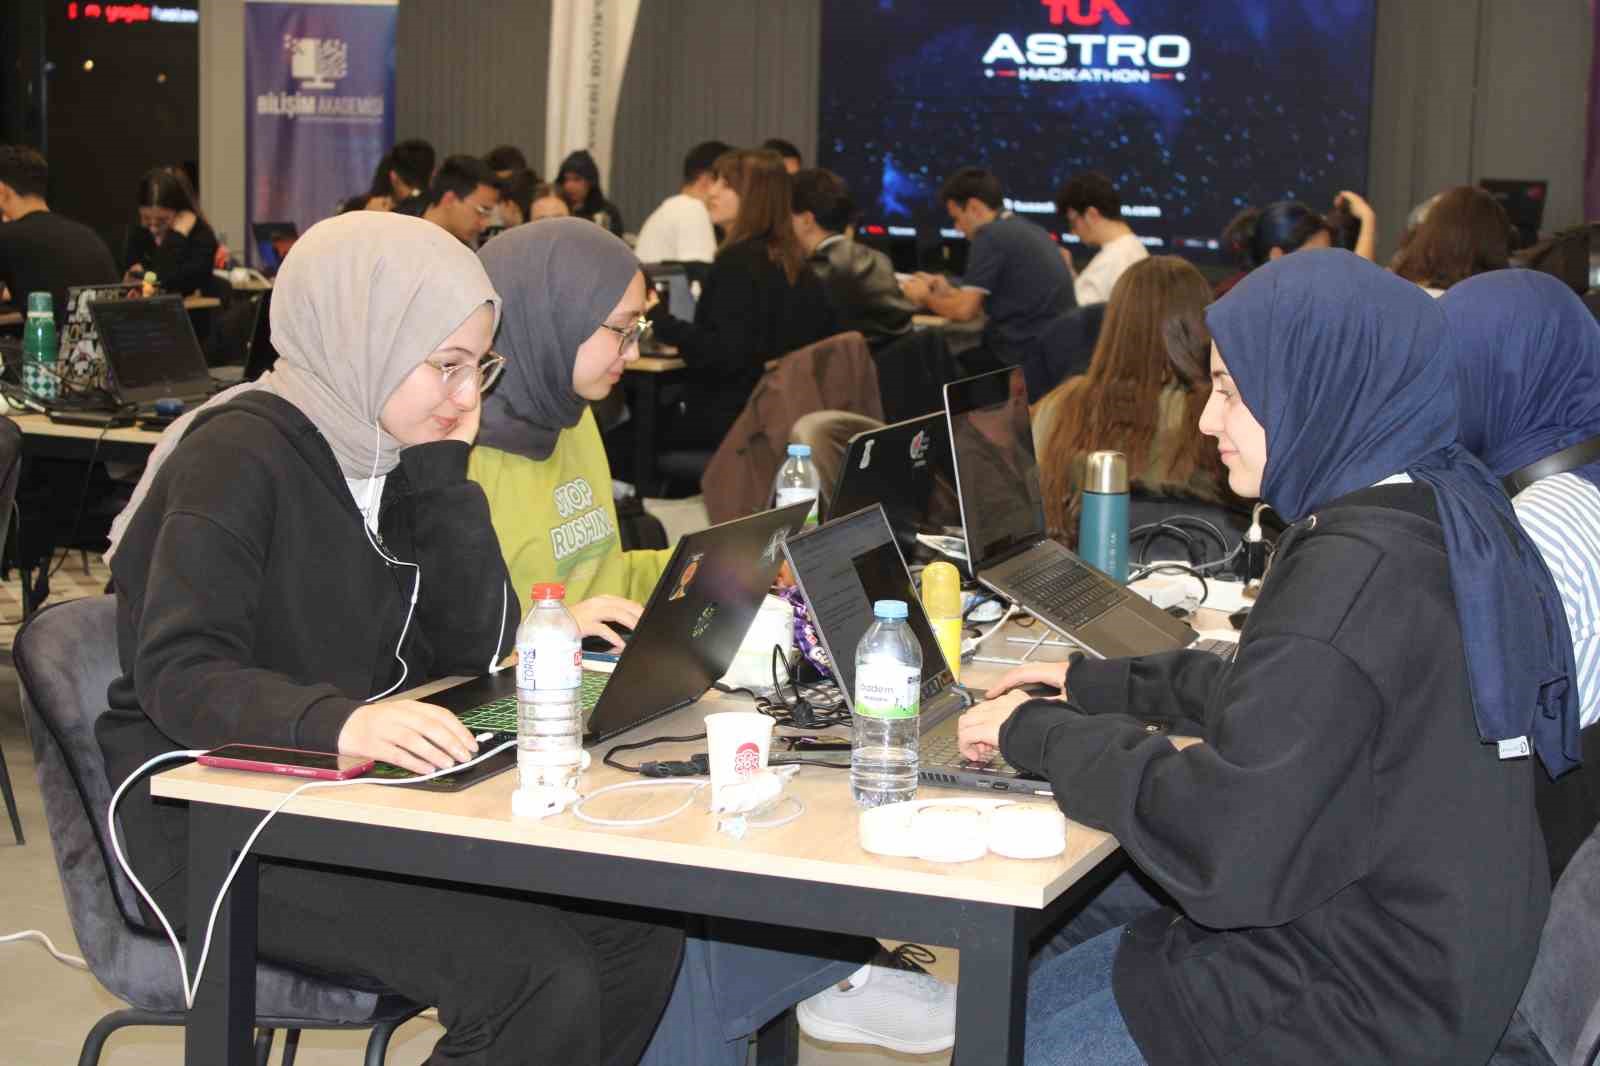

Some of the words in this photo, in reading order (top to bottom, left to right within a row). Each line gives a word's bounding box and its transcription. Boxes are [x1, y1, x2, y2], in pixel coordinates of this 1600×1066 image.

[981, 32, 1191, 68] ASTRO
[1018, 67, 1150, 83] HACKATHON
[554, 479, 593, 518] STOP
